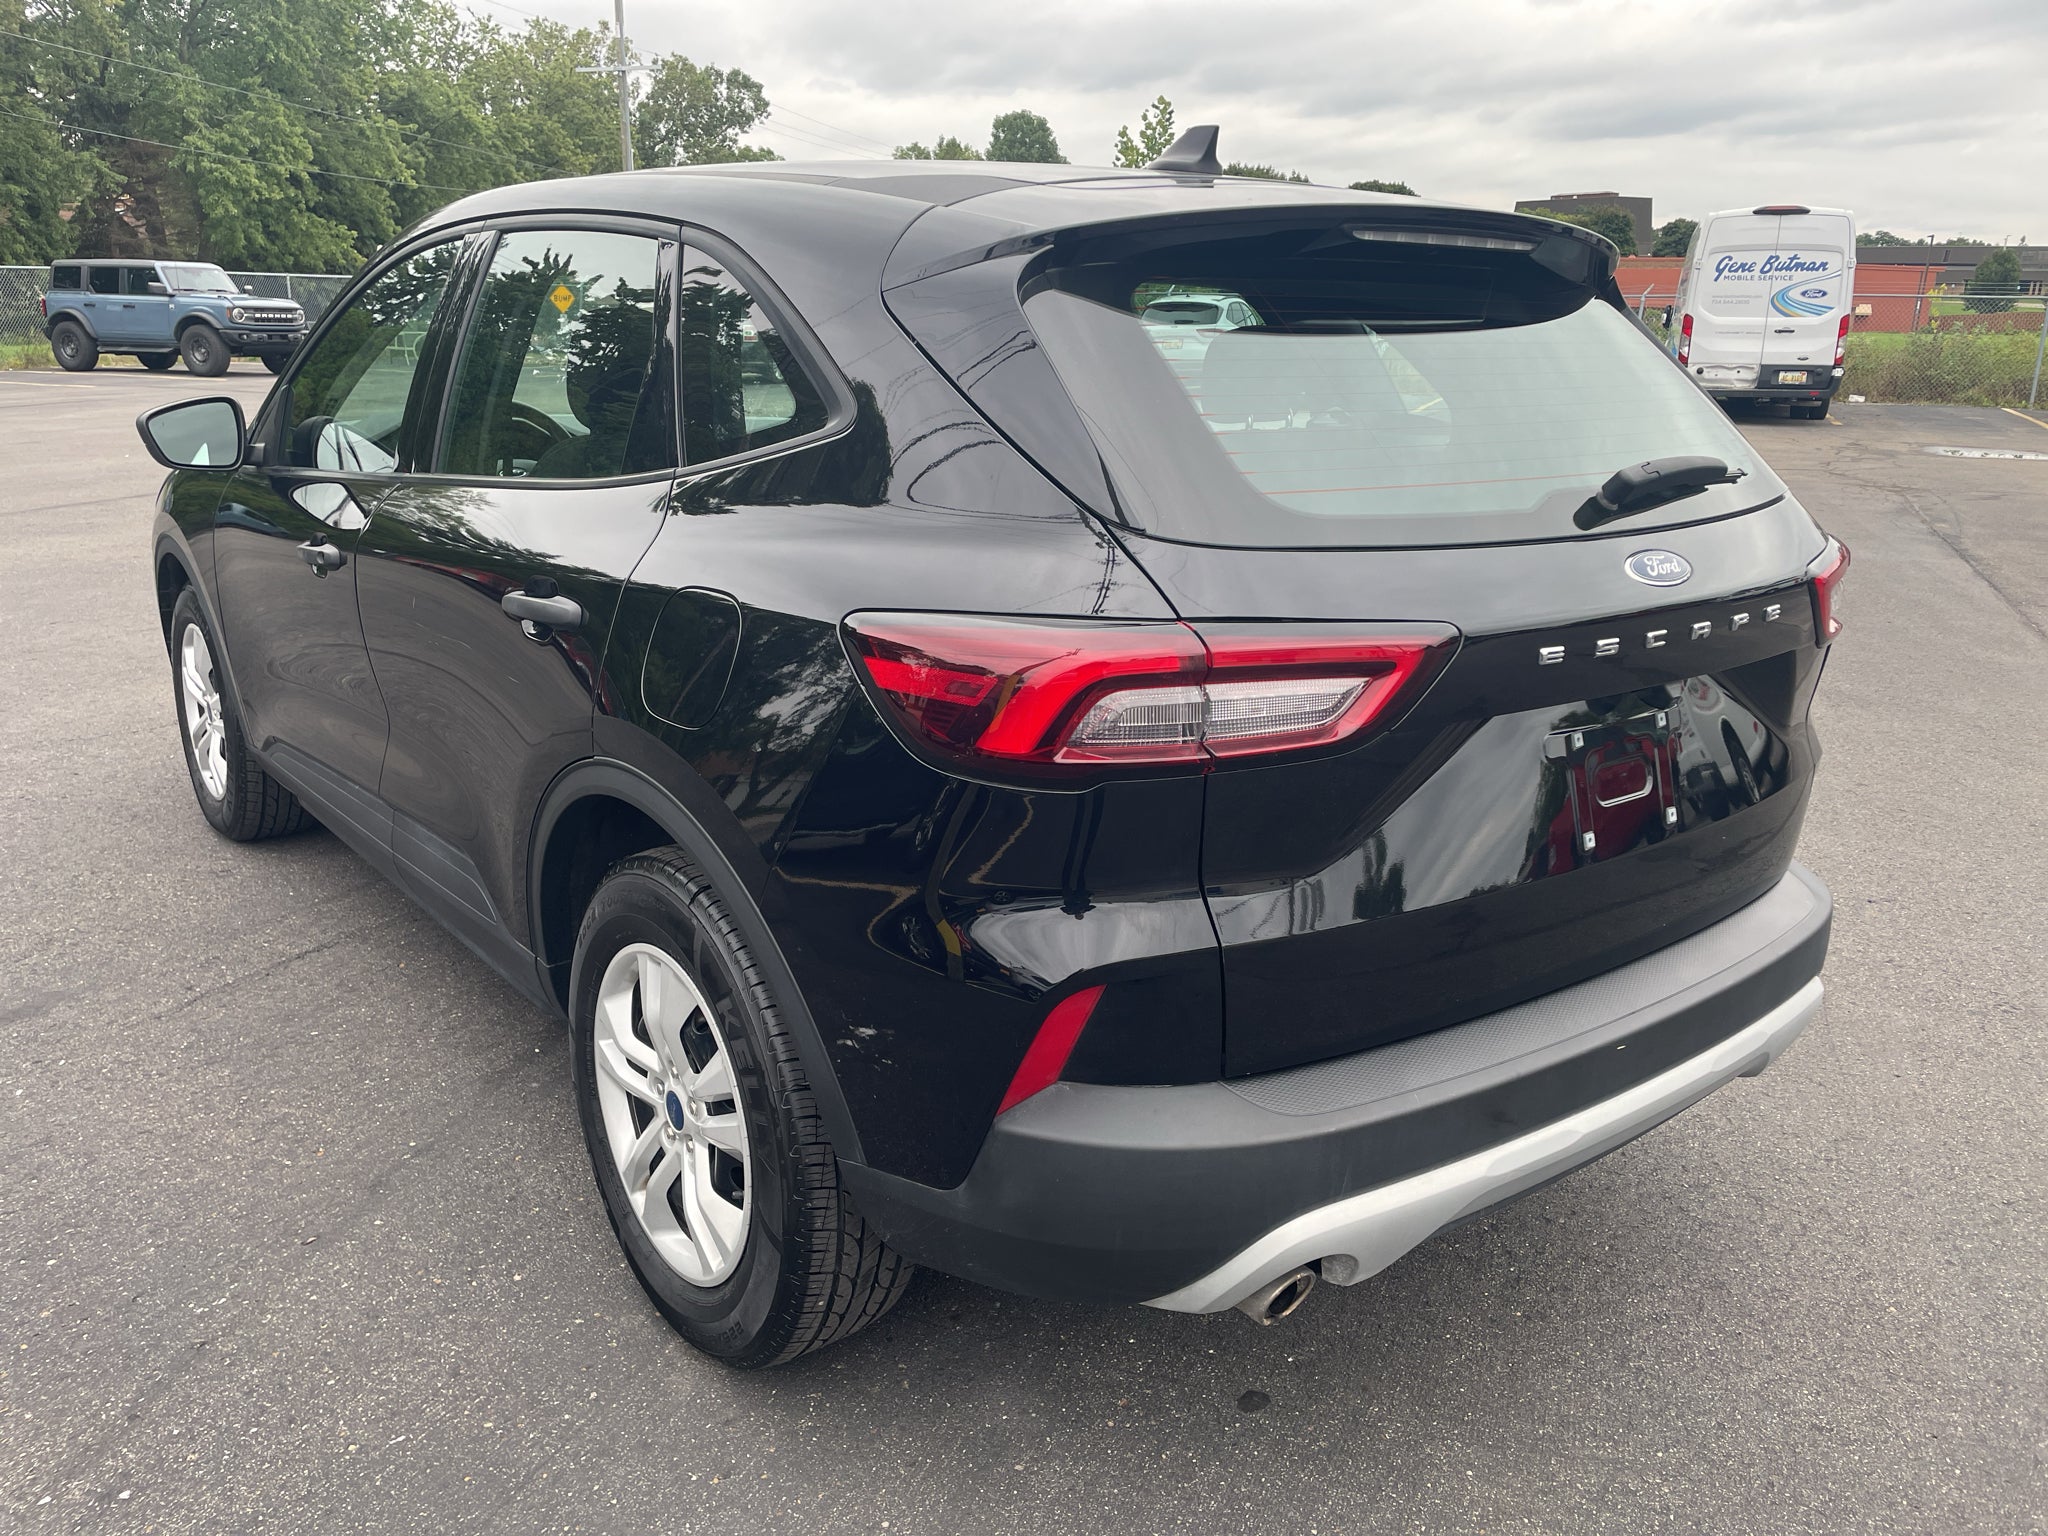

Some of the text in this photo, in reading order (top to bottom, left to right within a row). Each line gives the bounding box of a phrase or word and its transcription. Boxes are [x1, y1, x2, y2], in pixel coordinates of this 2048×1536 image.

[1713, 253, 1829, 282] Gene Butman
[1804, 288, 1823, 298] Ford
[1645, 555, 1681, 577] Ford
[1538, 603, 1782, 666] ESCAPE
